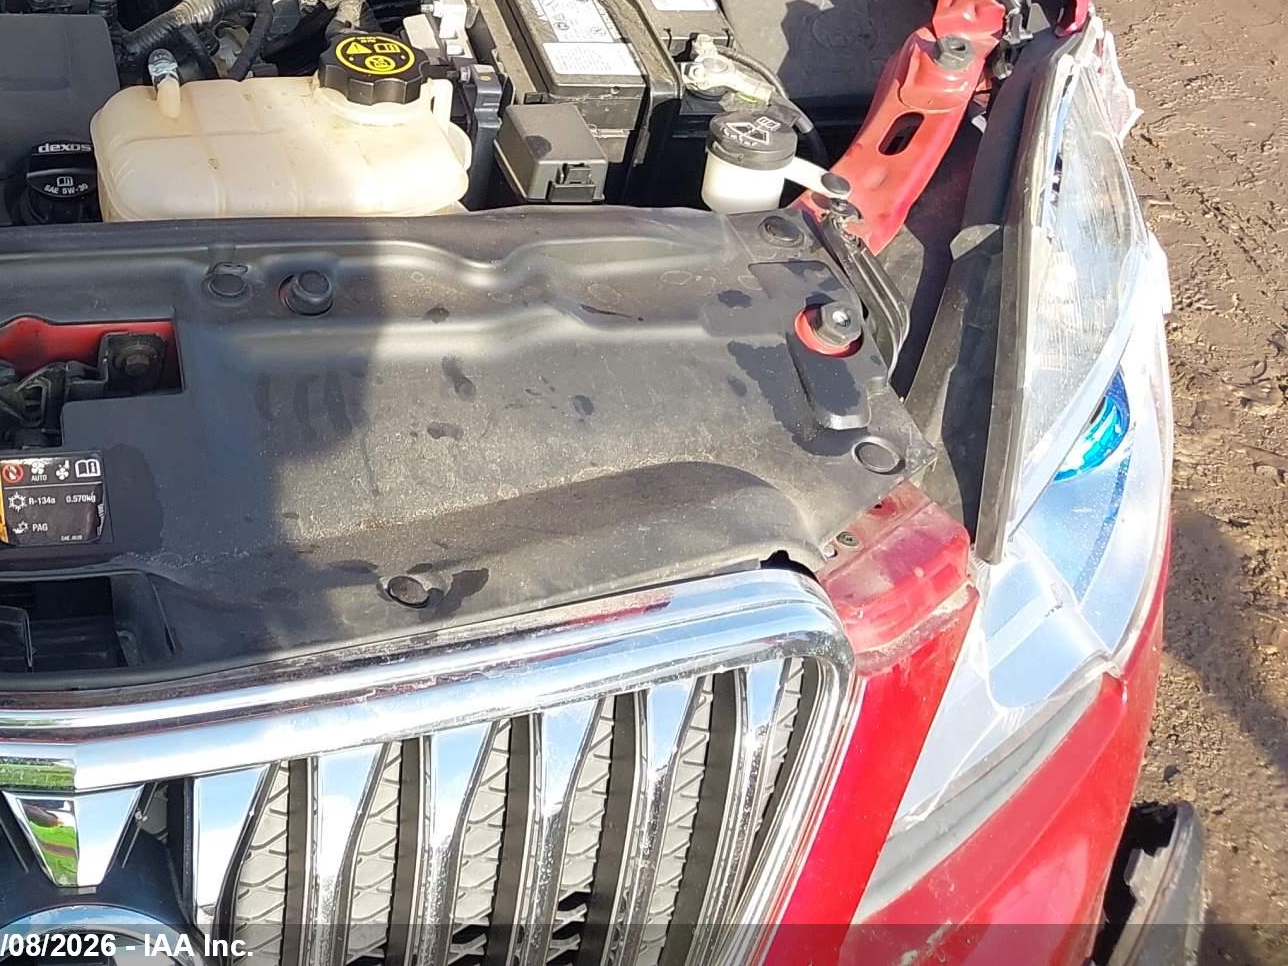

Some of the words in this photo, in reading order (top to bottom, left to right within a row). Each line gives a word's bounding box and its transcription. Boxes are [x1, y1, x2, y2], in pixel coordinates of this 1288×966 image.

[38, 143, 91, 153] dexos
[31, 474, 48, 482] AUTO
[28, 496, 56, 506] R-134a
[32, 523, 48, 532] PAG
